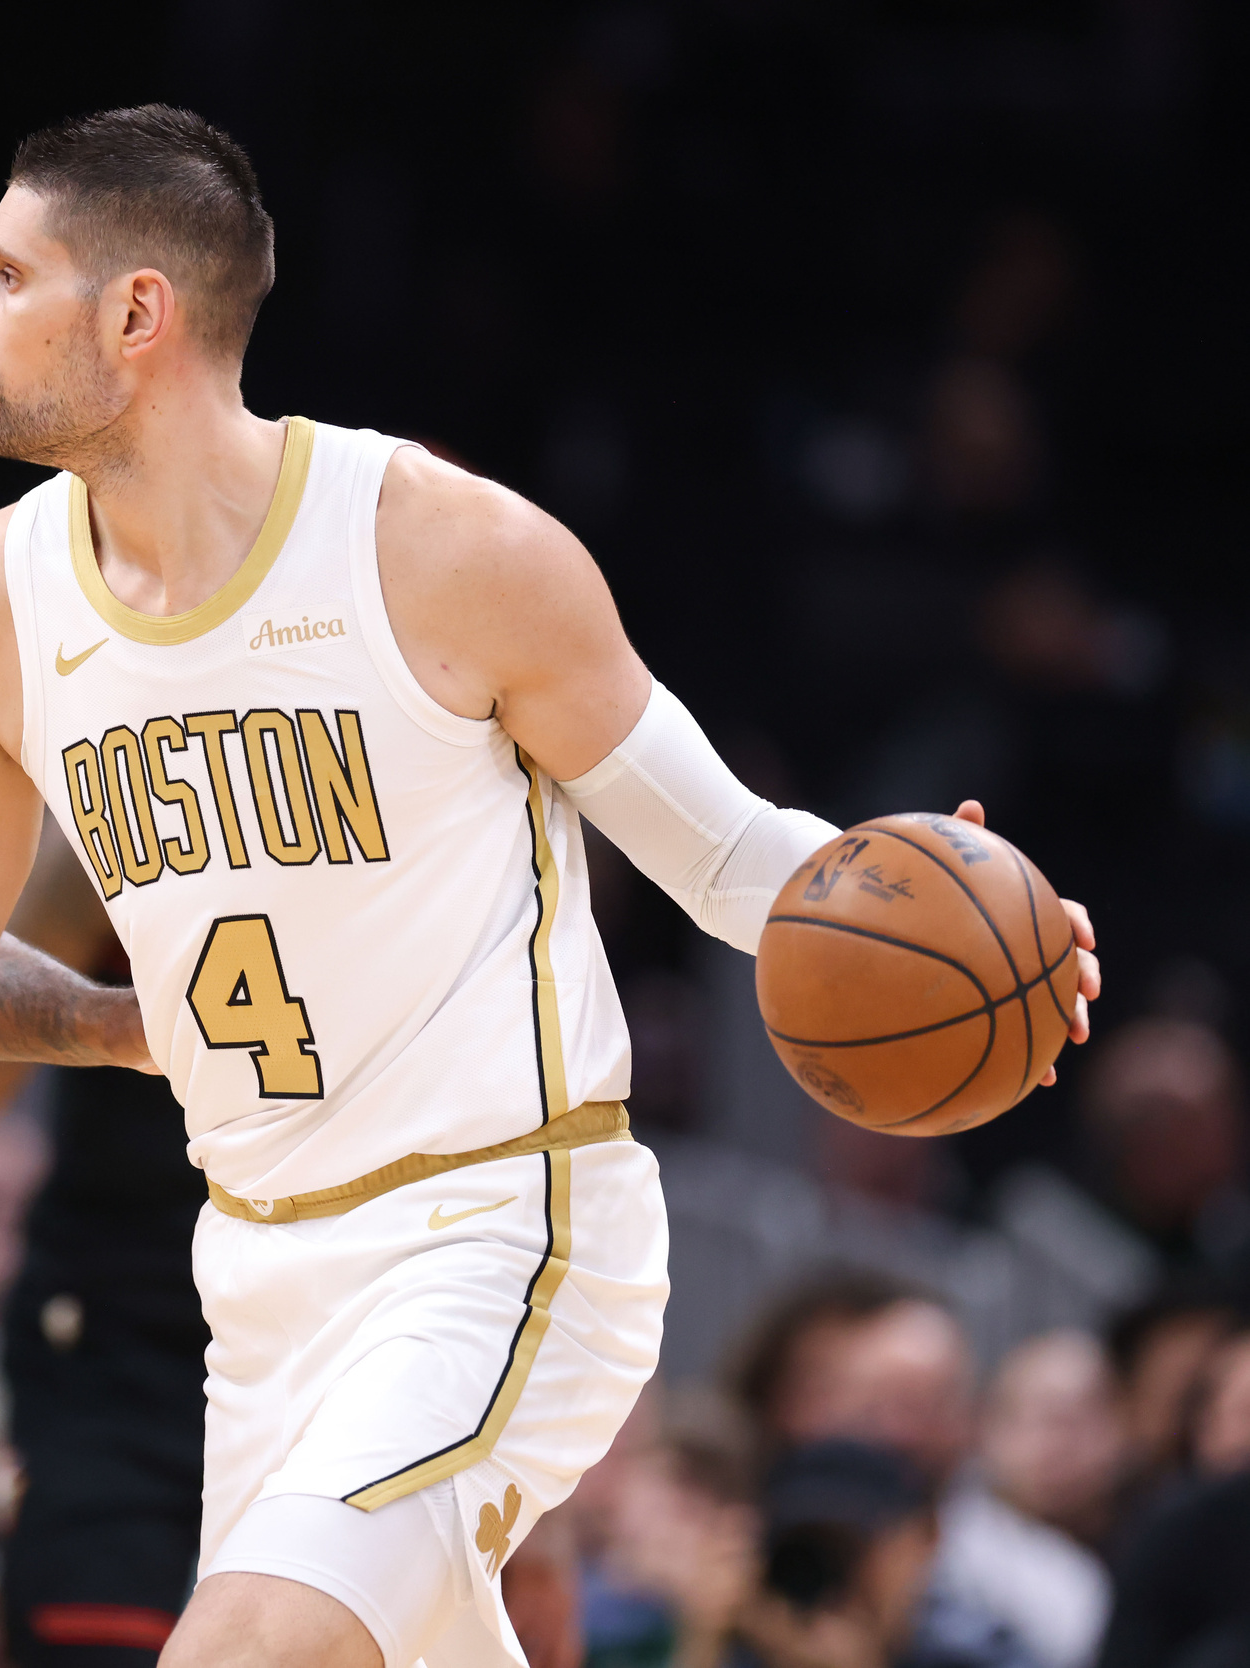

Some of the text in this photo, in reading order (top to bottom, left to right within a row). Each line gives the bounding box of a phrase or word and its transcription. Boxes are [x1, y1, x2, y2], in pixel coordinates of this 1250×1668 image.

[250, 616, 346, 650] Amica
[62, 708, 391, 901] BOSTON
[186, 914, 324, 1099] 4
